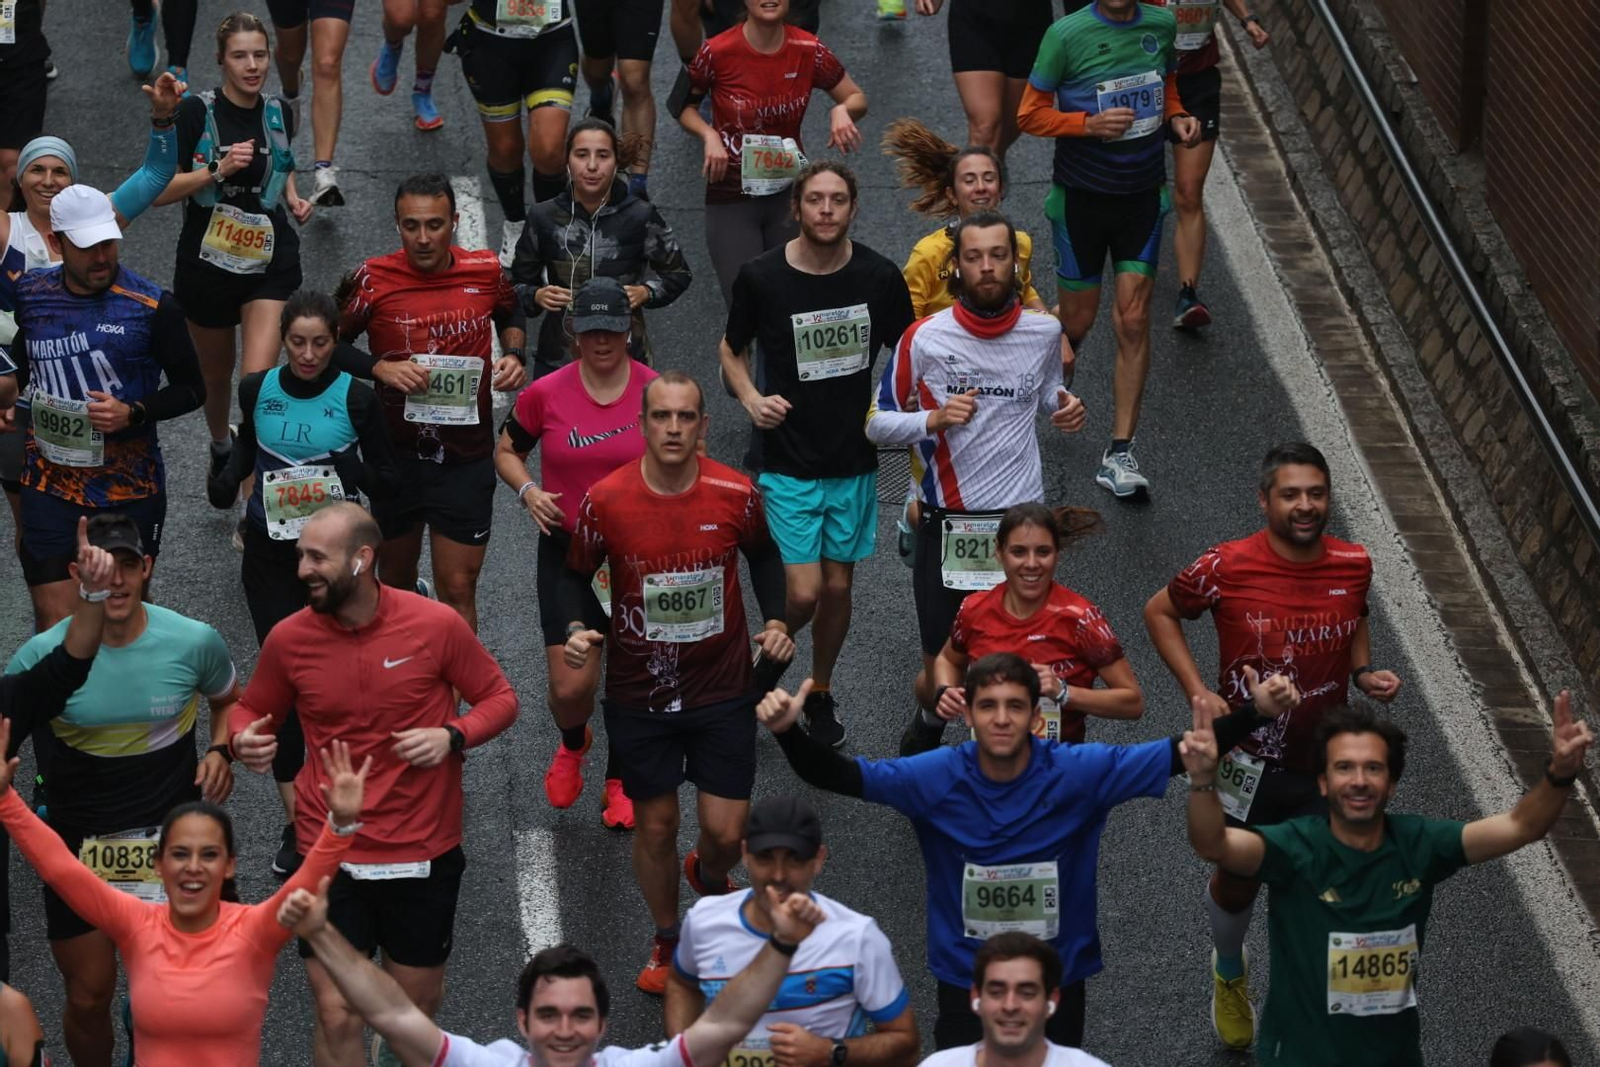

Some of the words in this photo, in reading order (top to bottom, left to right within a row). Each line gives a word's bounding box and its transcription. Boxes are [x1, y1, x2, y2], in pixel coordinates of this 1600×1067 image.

[1110, 88, 1151, 109] 1979
[753, 150, 794, 170] 7642
[216, 219, 266, 249] 11495
[96, 323, 125, 335] HOKA
[801, 323, 858, 351] 10261
[32, 332, 89, 359] MARATÓN
[40, 410, 84, 438] 9982
[280, 420, 313, 445] LR
[275, 482, 326, 508] 7845
[955, 538, 997, 559] 821
[657, 587, 707, 613] 6867
[88, 845, 155, 869] 10838
[976, 884, 1036, 909] 9664
[1337, 950, 1409, 979] 14865
